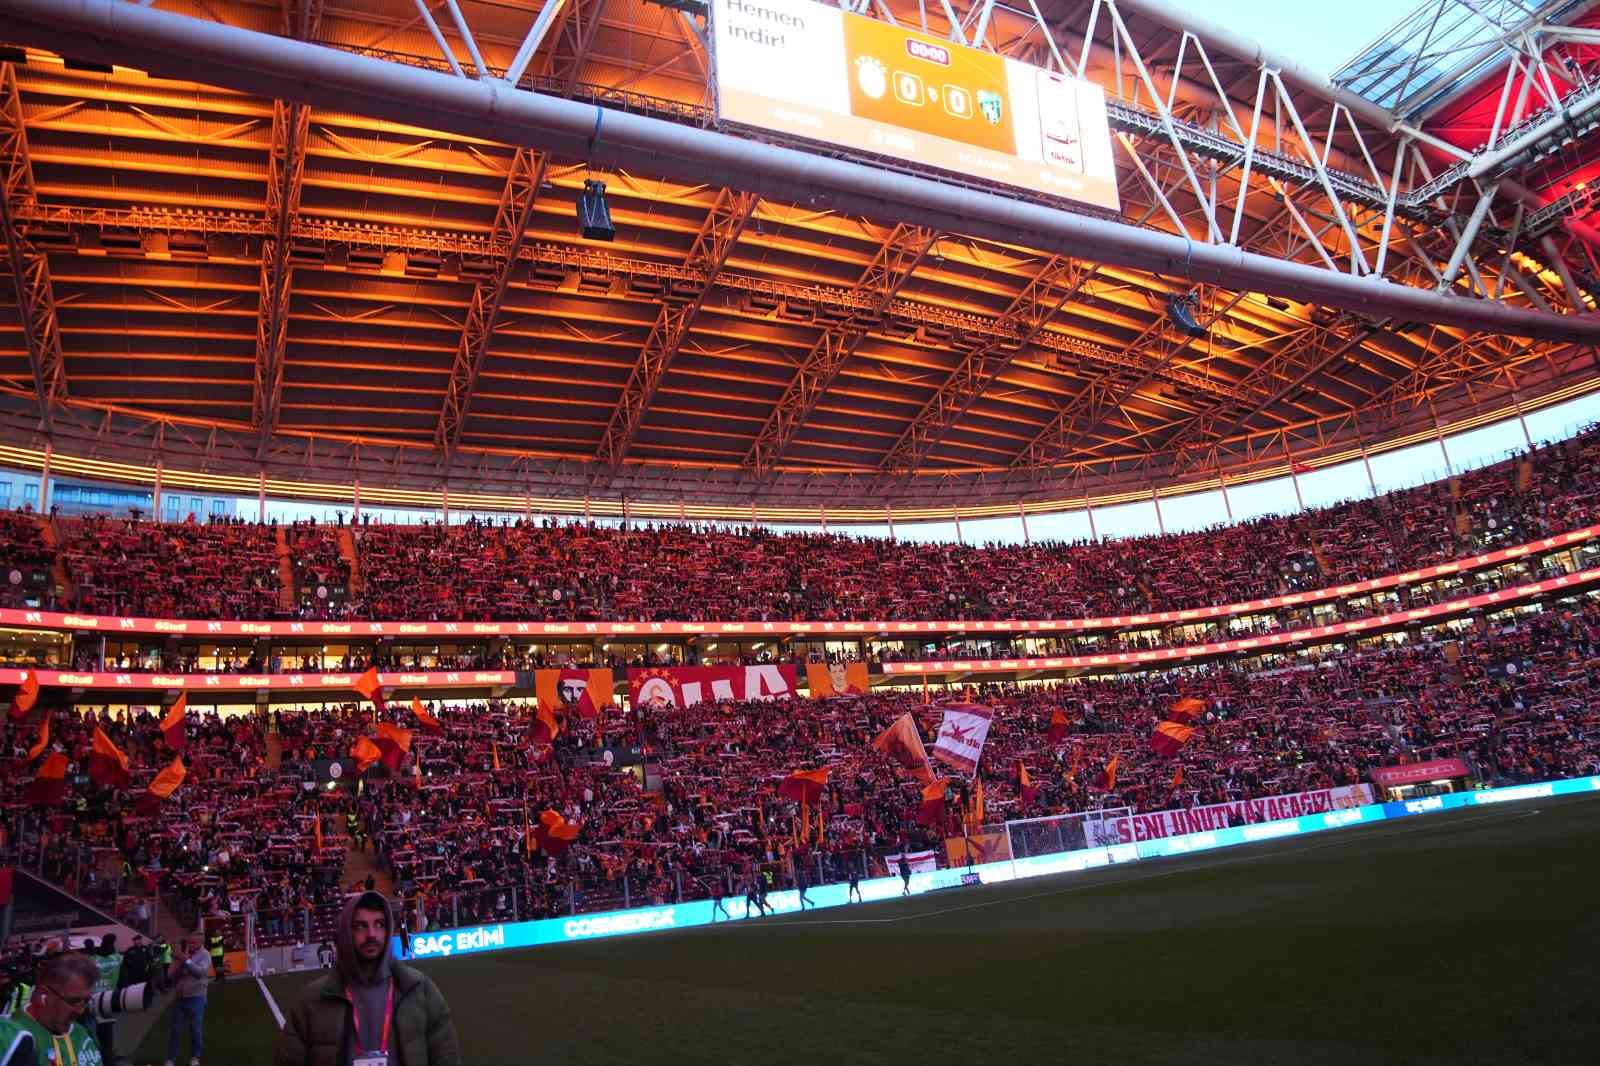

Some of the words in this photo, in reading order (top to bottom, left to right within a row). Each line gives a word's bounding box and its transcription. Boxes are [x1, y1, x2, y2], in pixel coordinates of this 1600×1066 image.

[727, 0, 806, 30] Hemen
[728, 19, 785, 48] indir!
[901, 76, 916, 100] 0
[949, 90, 965, 114] 0
[412, 934, 453, 956] SAÇ
[456, 925, 505, 950] EKİMİ
